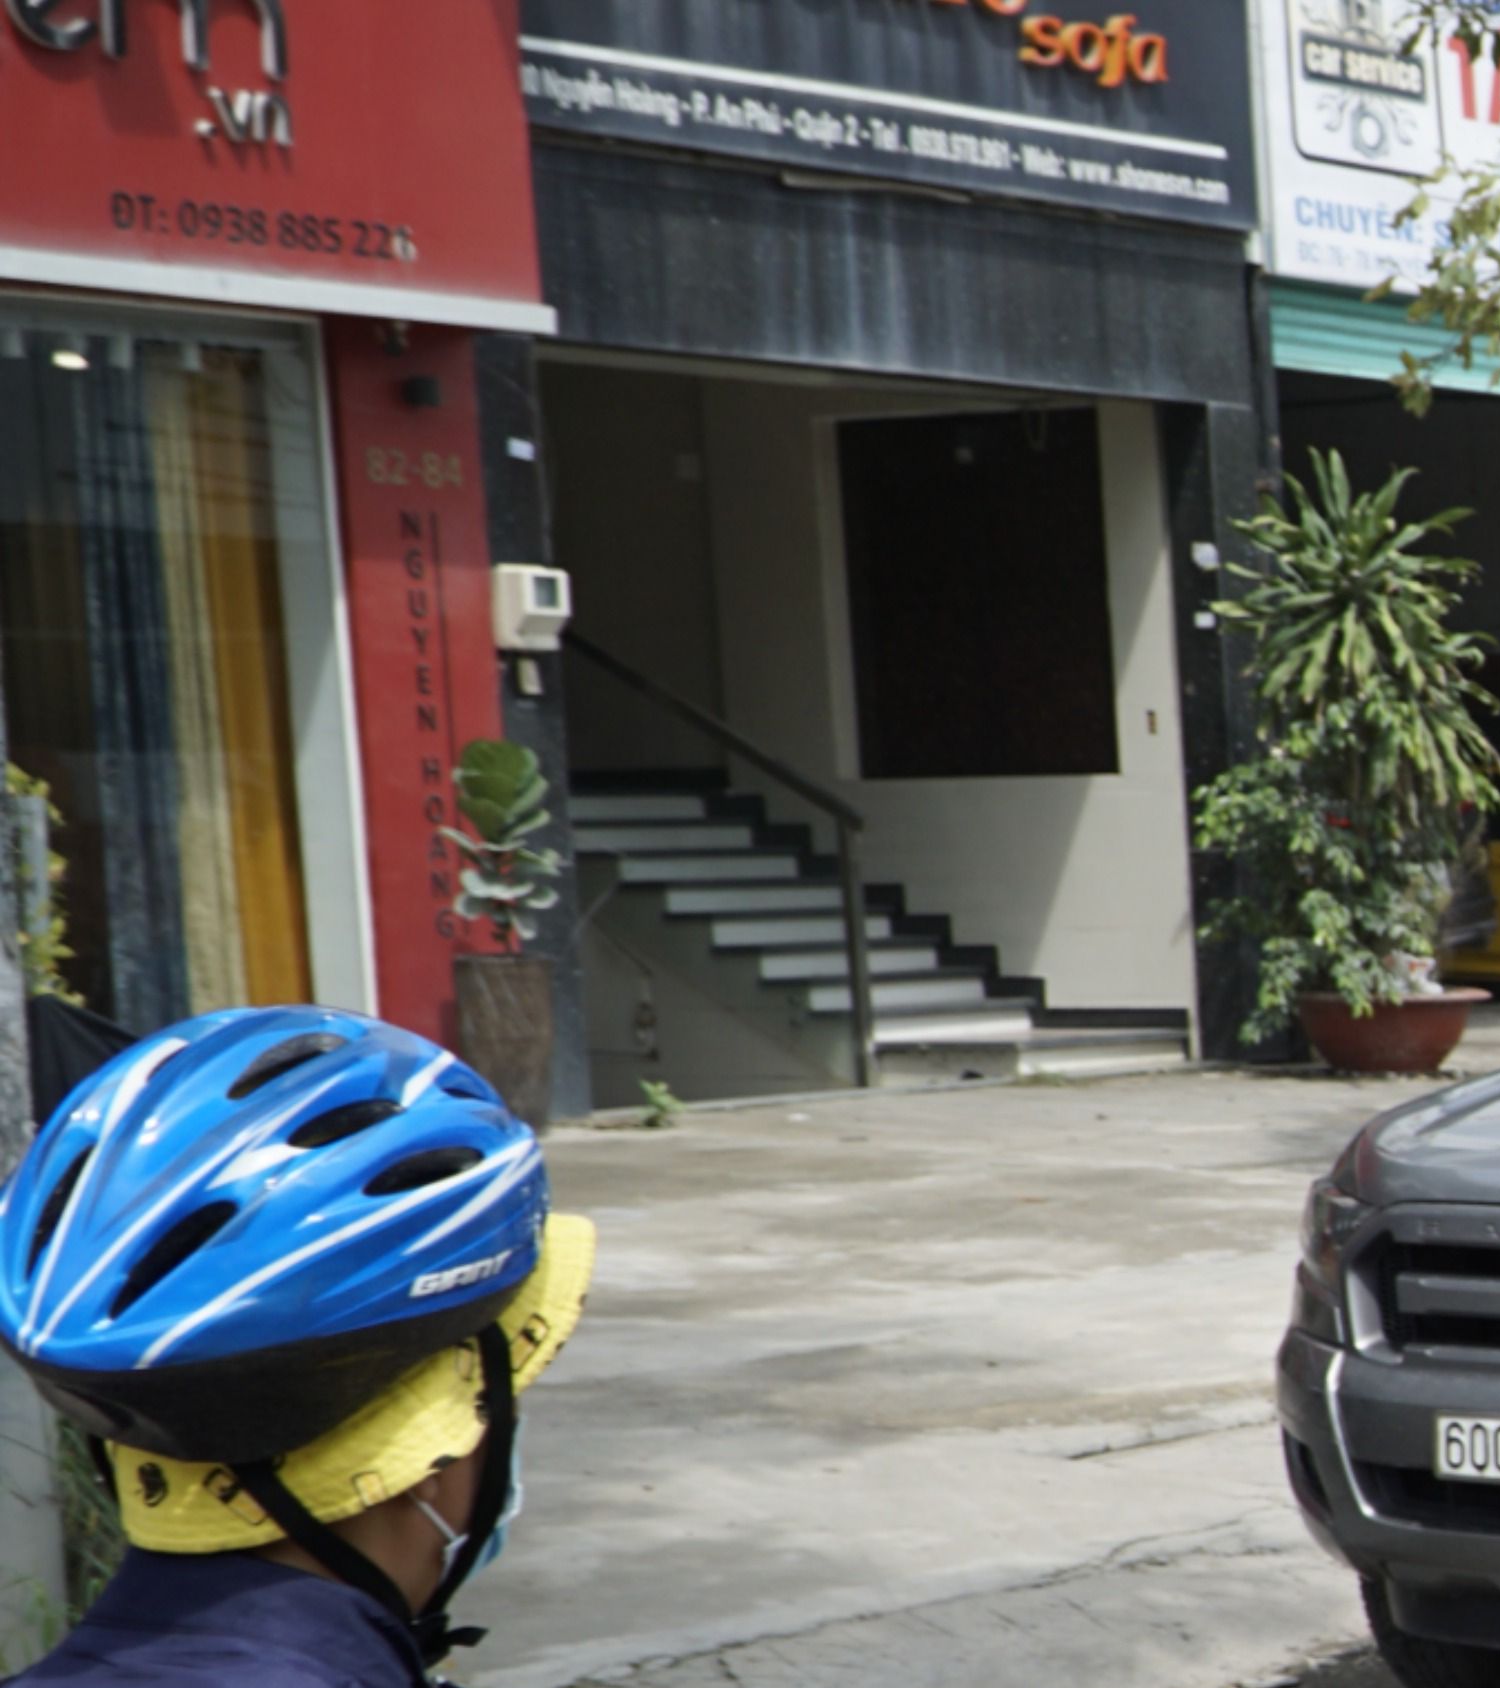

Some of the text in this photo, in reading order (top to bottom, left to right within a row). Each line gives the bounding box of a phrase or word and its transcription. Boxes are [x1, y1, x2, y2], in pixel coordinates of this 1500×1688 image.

[1018, 14, 1169, 88] sofa
[179, 201, 268, 247] 0938
[277, 212, 343, 255] 885
[364, 448, 463, 487] 82-84
